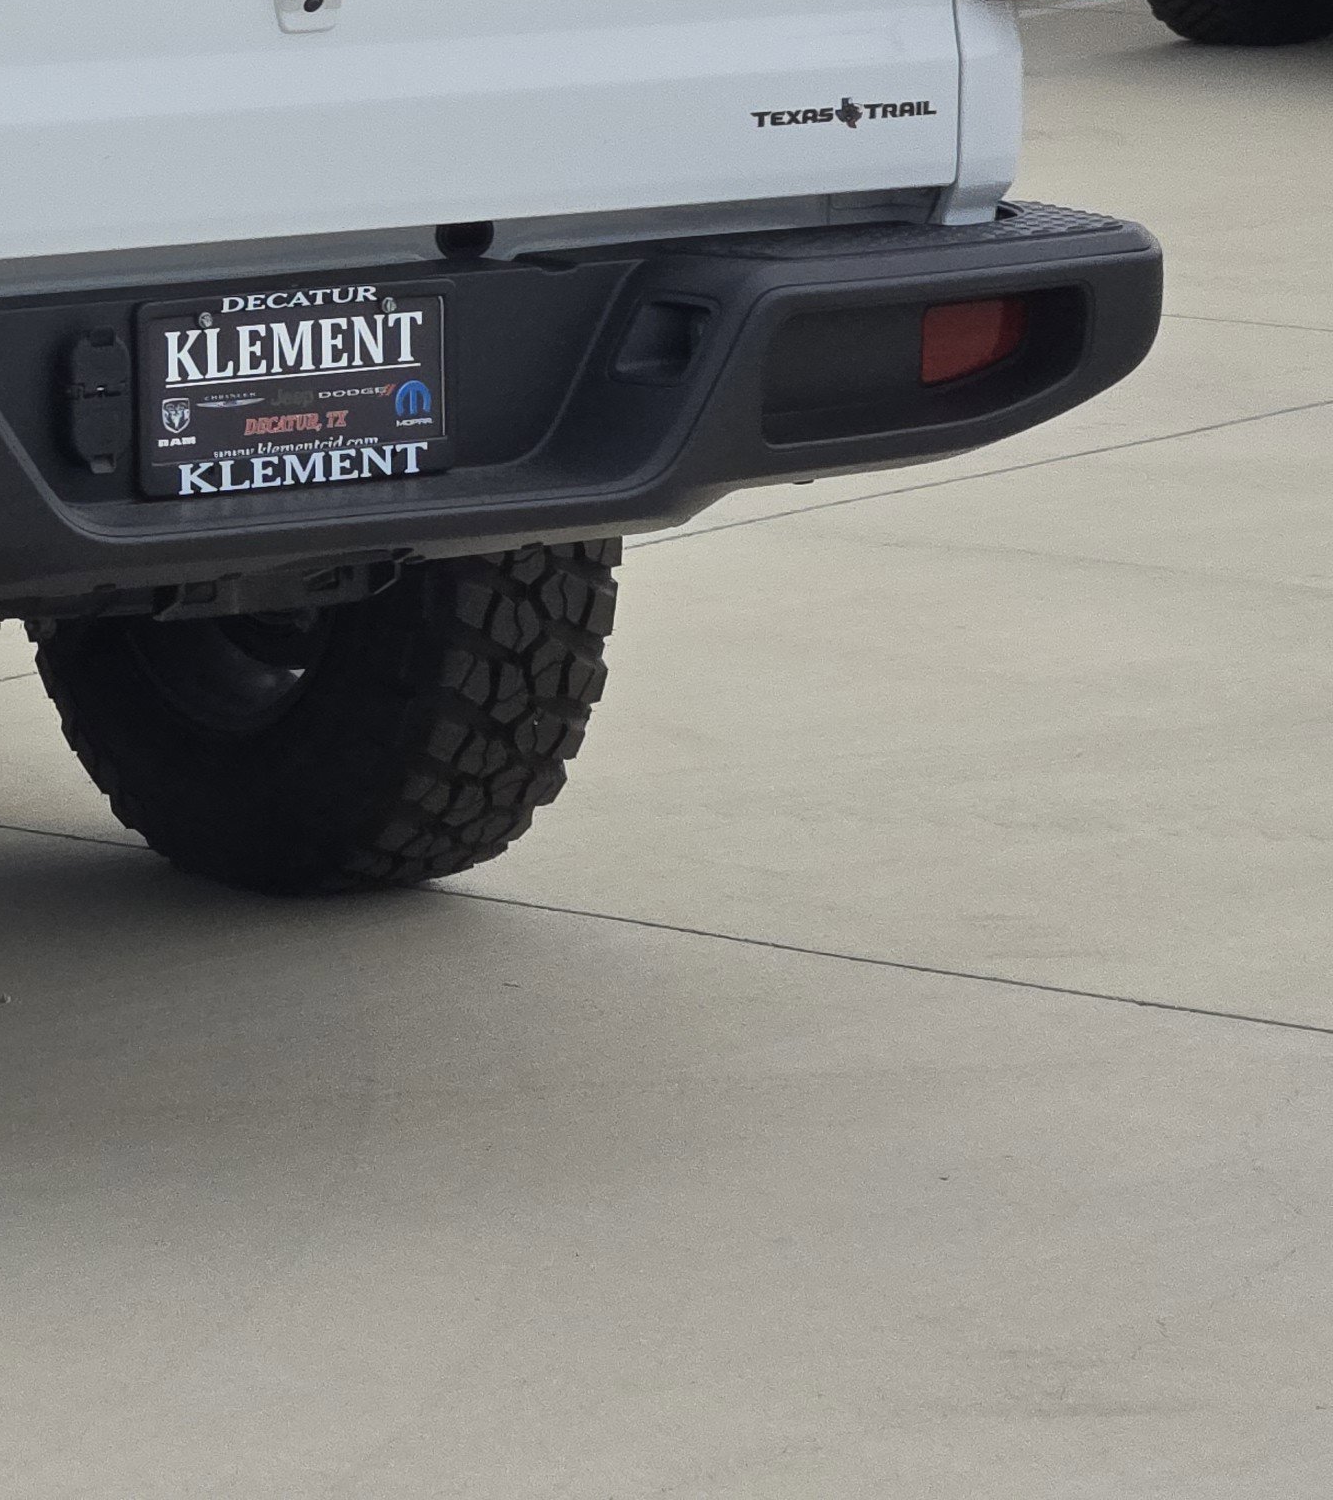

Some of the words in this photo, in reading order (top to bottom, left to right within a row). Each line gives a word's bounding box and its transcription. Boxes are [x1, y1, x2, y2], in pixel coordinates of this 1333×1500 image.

[750, 107, 834, 127] TEXAS
[864, 100, 937, 120] TRAIL
[221, 285, 377, 313] DECATUR
[165, 311, 423, 382] KLEMENT
[318, 386, 388, 399] DODGE
[326, 410, 349, 429] TX
[158, 436, 197, 448] RAM
[178, 441, 428, 496] KLEMENT
